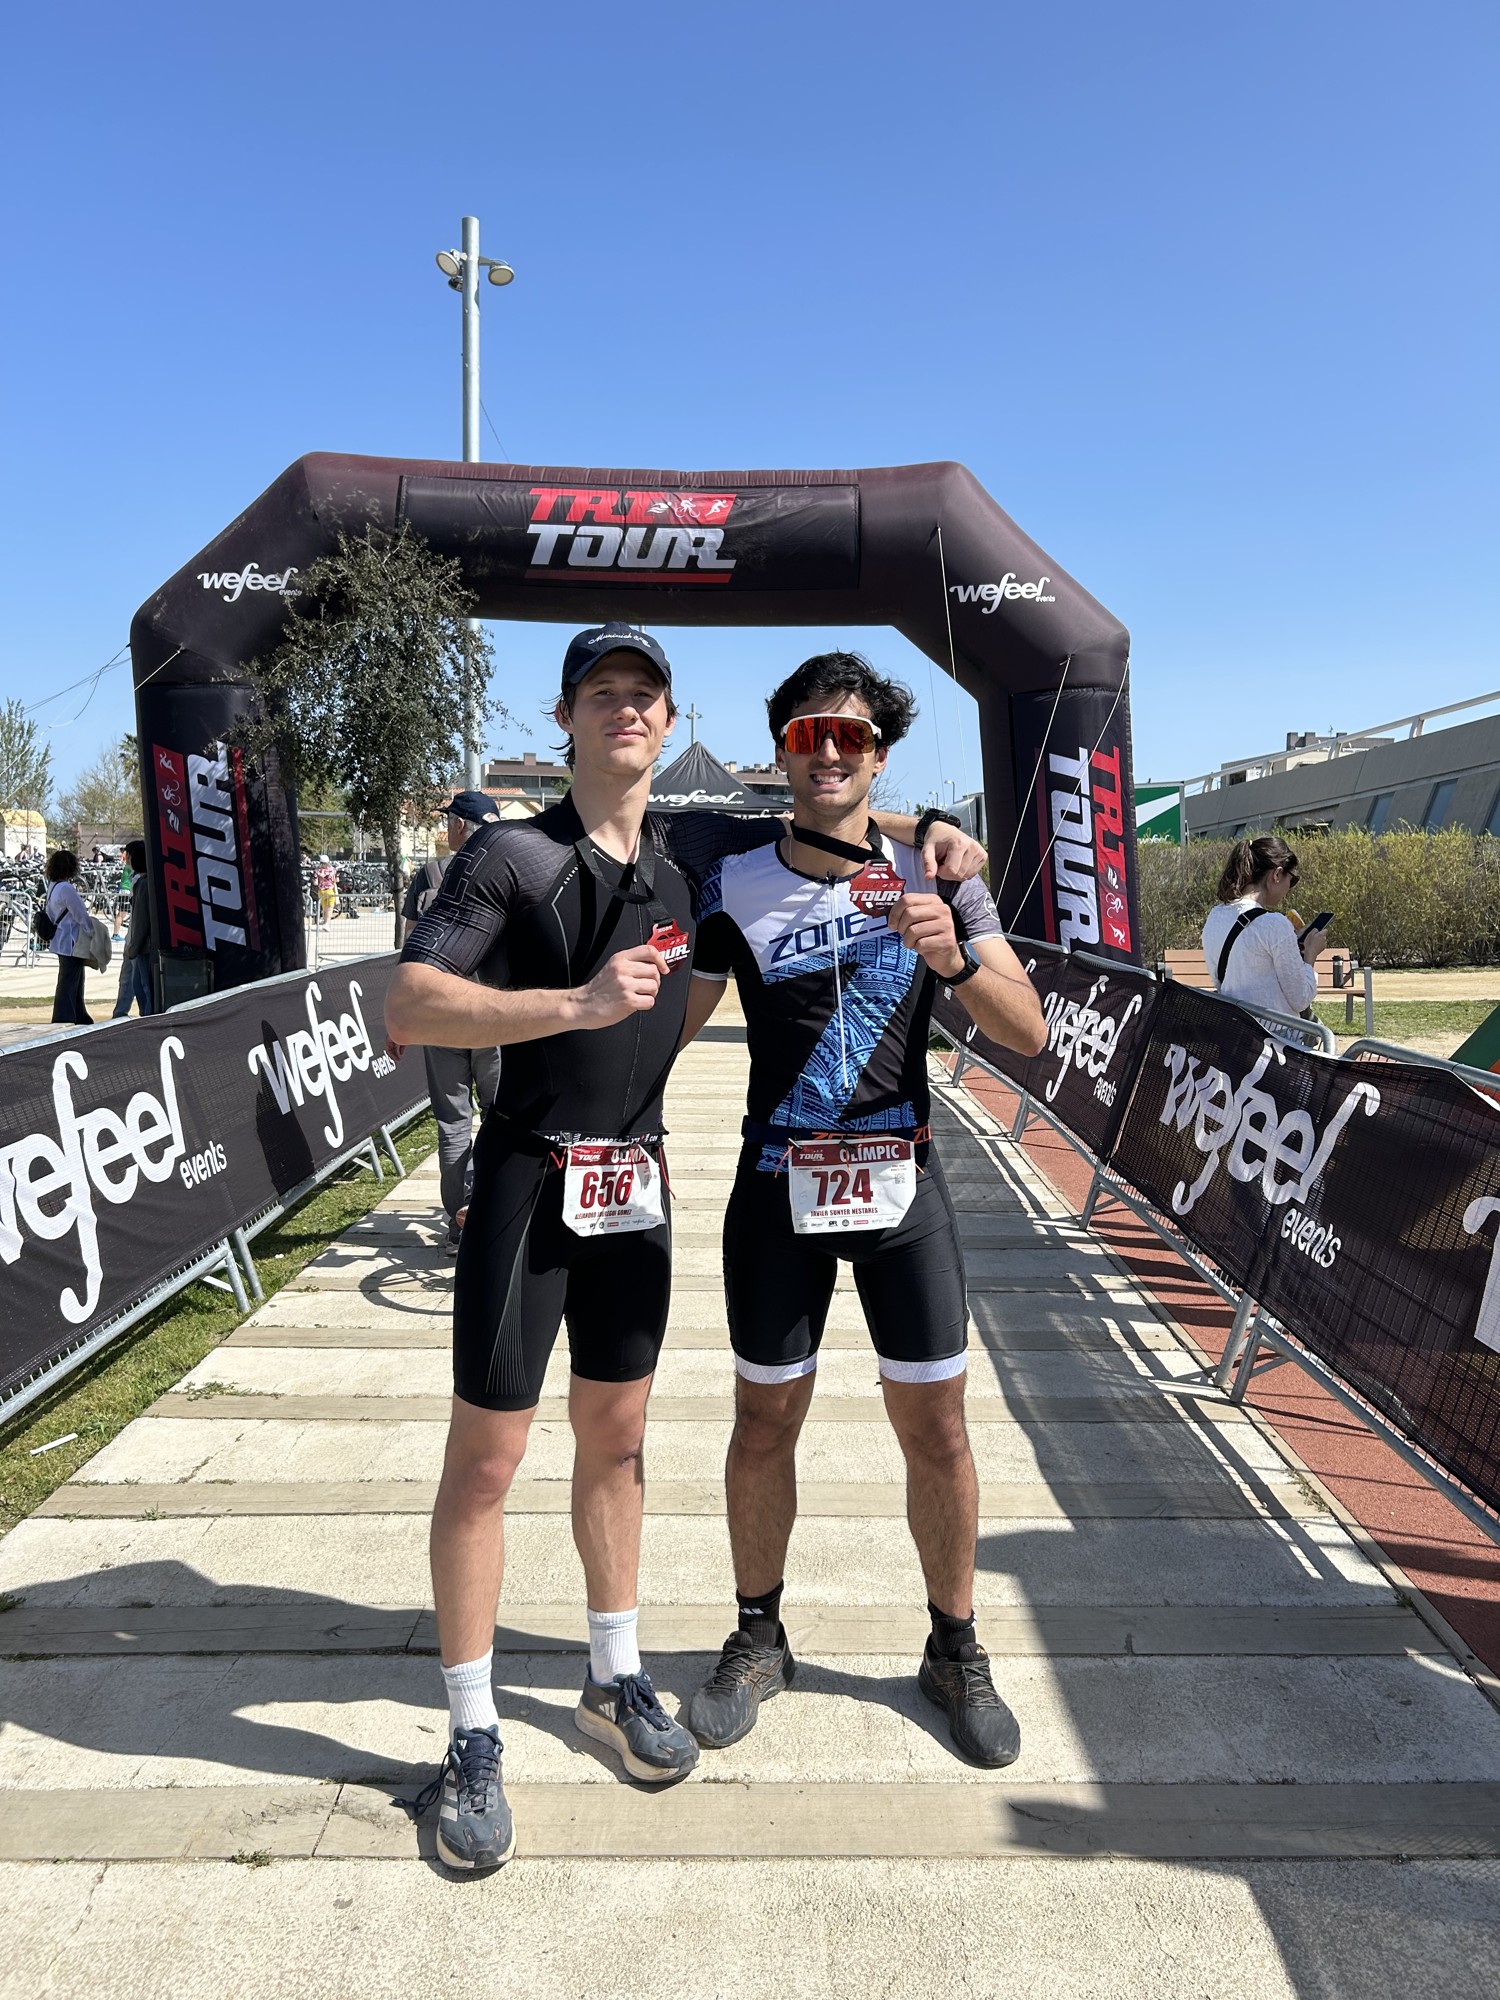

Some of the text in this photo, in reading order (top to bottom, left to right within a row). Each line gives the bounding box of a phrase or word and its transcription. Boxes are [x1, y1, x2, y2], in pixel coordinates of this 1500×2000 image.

[529, 488, 665, 524] TRI
[526, 524, 737, 569] TOUR
[197, 562, 299, 603] wefeel
[949, 572, 1051, 615] wefeel
[1035, 595, 1056, 603] events
[648, 789, 744, 807] wefeel
[1091, 746, 1126, 881] TRI
[187, 741, 247, 951] TOUR
[1049, 746, 1100, 953] TOUR
[159, 817, 203, 948] TRI
[850, 890, 902, 902] TOUR
[660, 943, 691, 961] UR
[1043, 974, 1142, 1103] wefeel
[247, 980, 374, 1148] wefeel
[371, 1054, 397, 1079] events
[1093, 1076, 1117, 1107] events
[1163, 1037, 1381, 1216] wefeel
[180, 1140, 228, 1190] events
[799, 1153, 826, 1161] TOUR
[839, 1143, 900, 1163] OLÍMPIC
[580, 1170, 635, 1209] 656
[811, 1168, 874, 1207] 724
[810, 1208, 829, 1217] JAVIER
[851, 1207, 879, 1215] NESTARES
[1281, 1206, 1342, 1269] events
